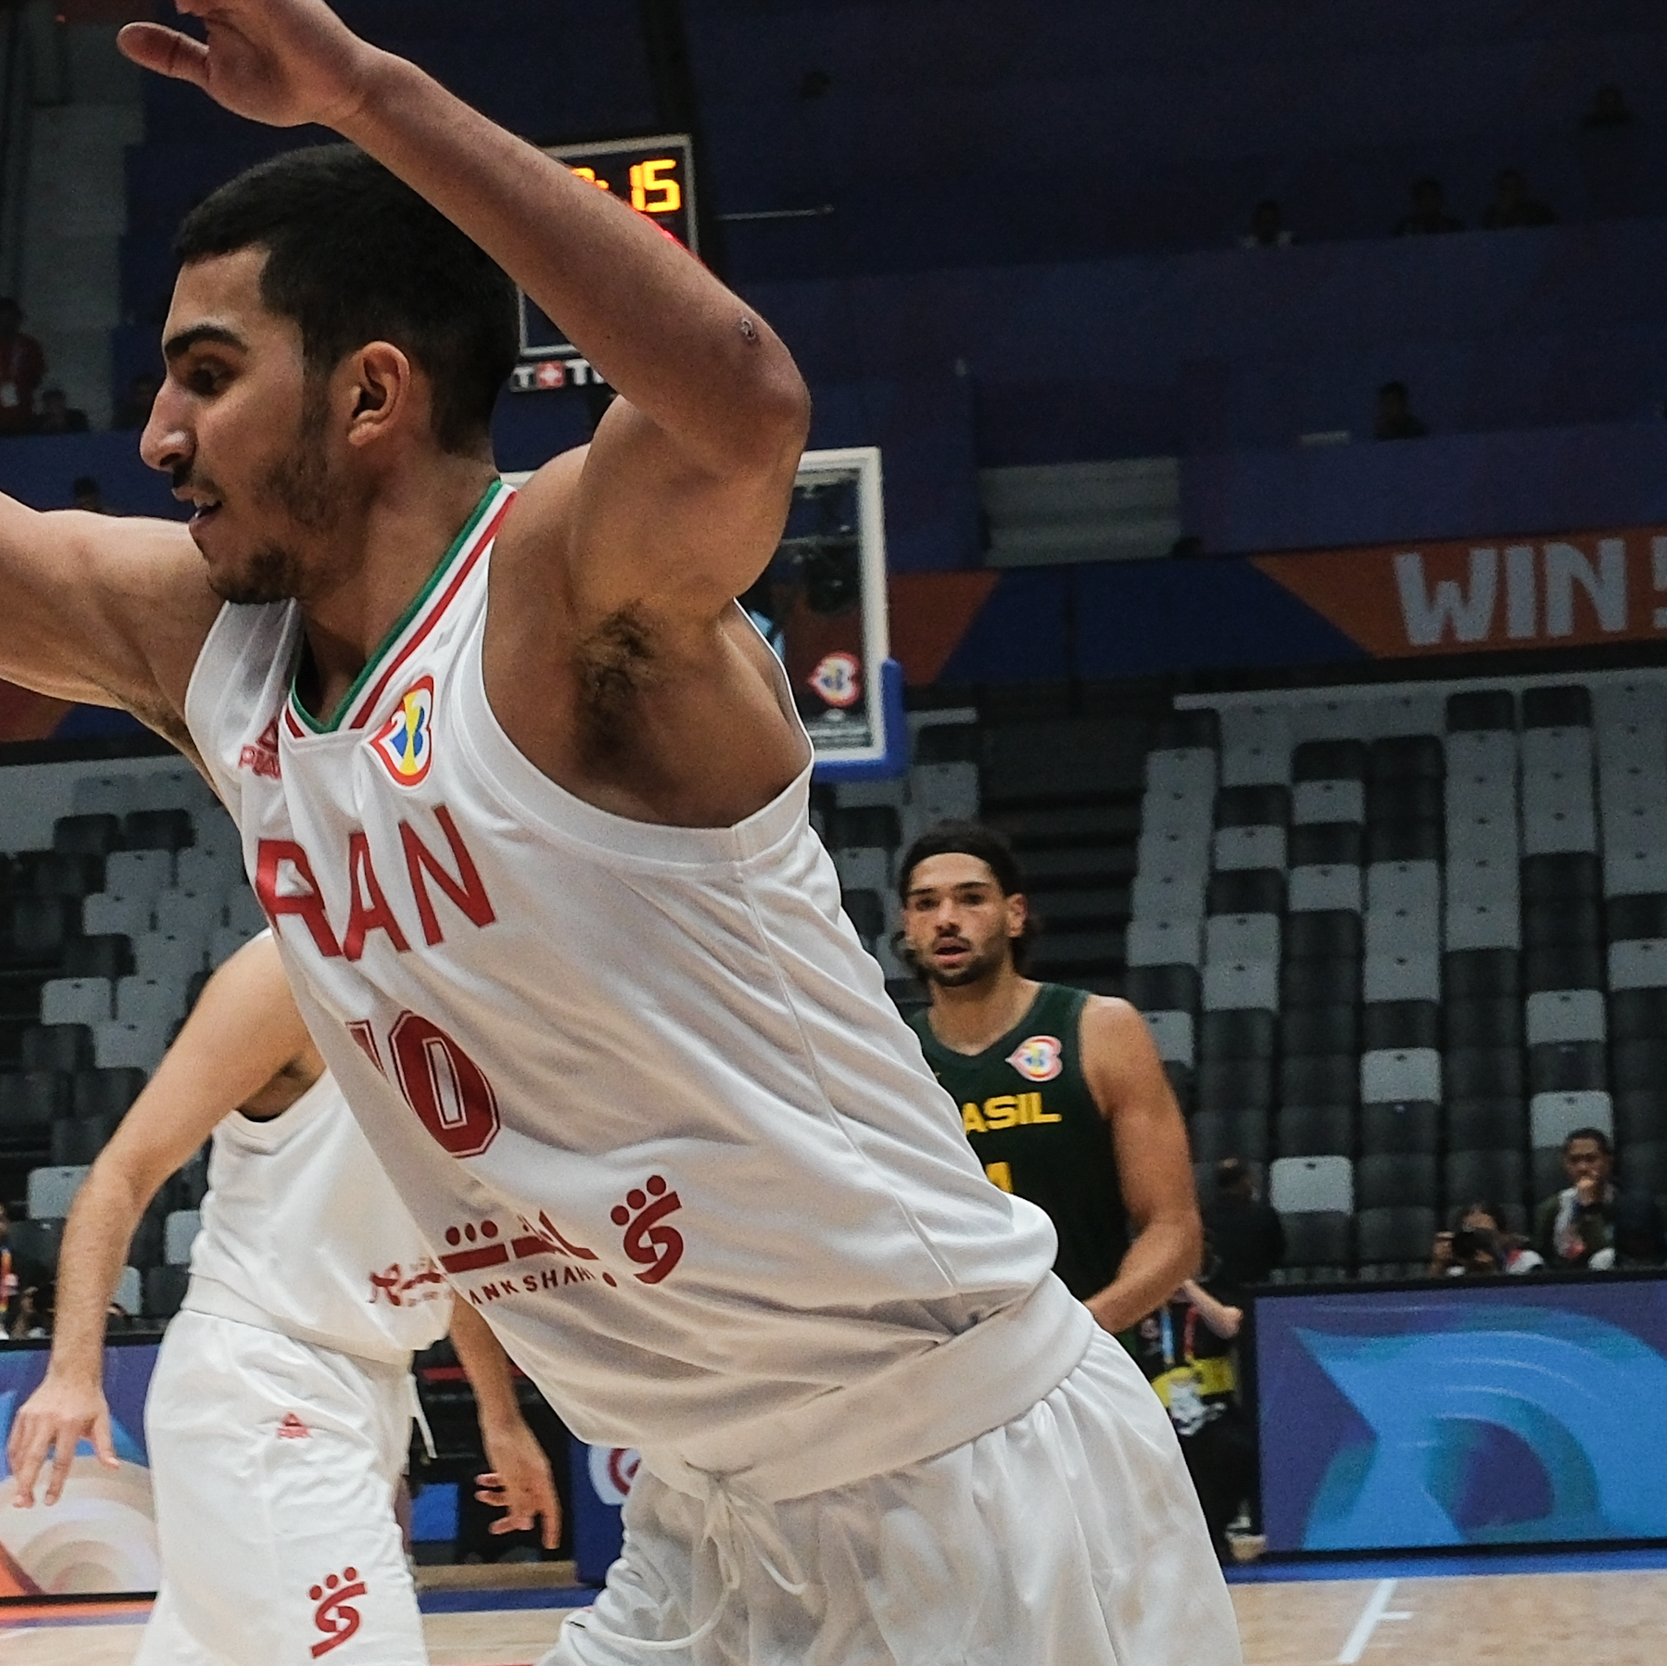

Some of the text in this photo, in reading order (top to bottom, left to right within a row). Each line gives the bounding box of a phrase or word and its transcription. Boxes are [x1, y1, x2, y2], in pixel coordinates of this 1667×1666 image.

[255, 802, 497, 962] RAN
[962, 1091, 1063, 1135] ASIL
[469, 1278, 520, 1307] ANK
